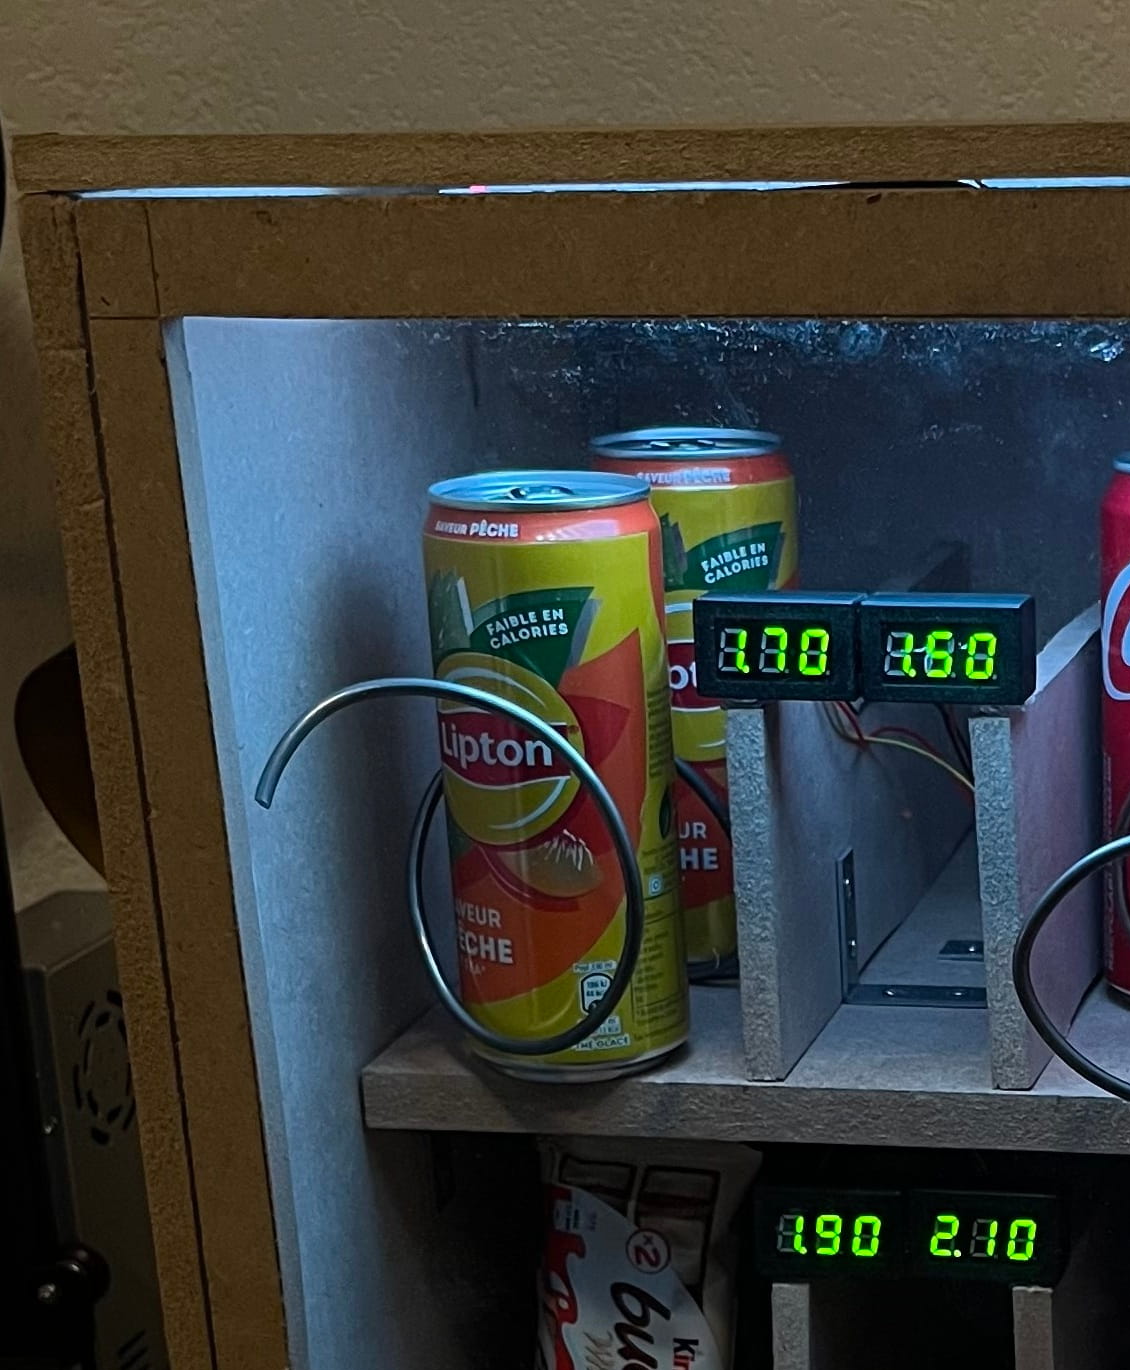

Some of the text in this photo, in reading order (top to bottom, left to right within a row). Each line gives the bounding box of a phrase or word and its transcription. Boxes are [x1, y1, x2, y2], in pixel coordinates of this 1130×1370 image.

[469, 518, 519, 538] PÊCHE
[700, 542, 766, 573] FAIBLE EN
[704, 555, 769, 584] CALORIES
[486, 607, 564, 637] FAIBLE EN
[489, 622, 569, 650] CALORIES
[735, 627, 830, 677] 1.70
[441, 720, 553, 769] Lipton
[793, 1214, 882, 1257] 1.90
[929, 1215, 1037, 1261] 2.10
